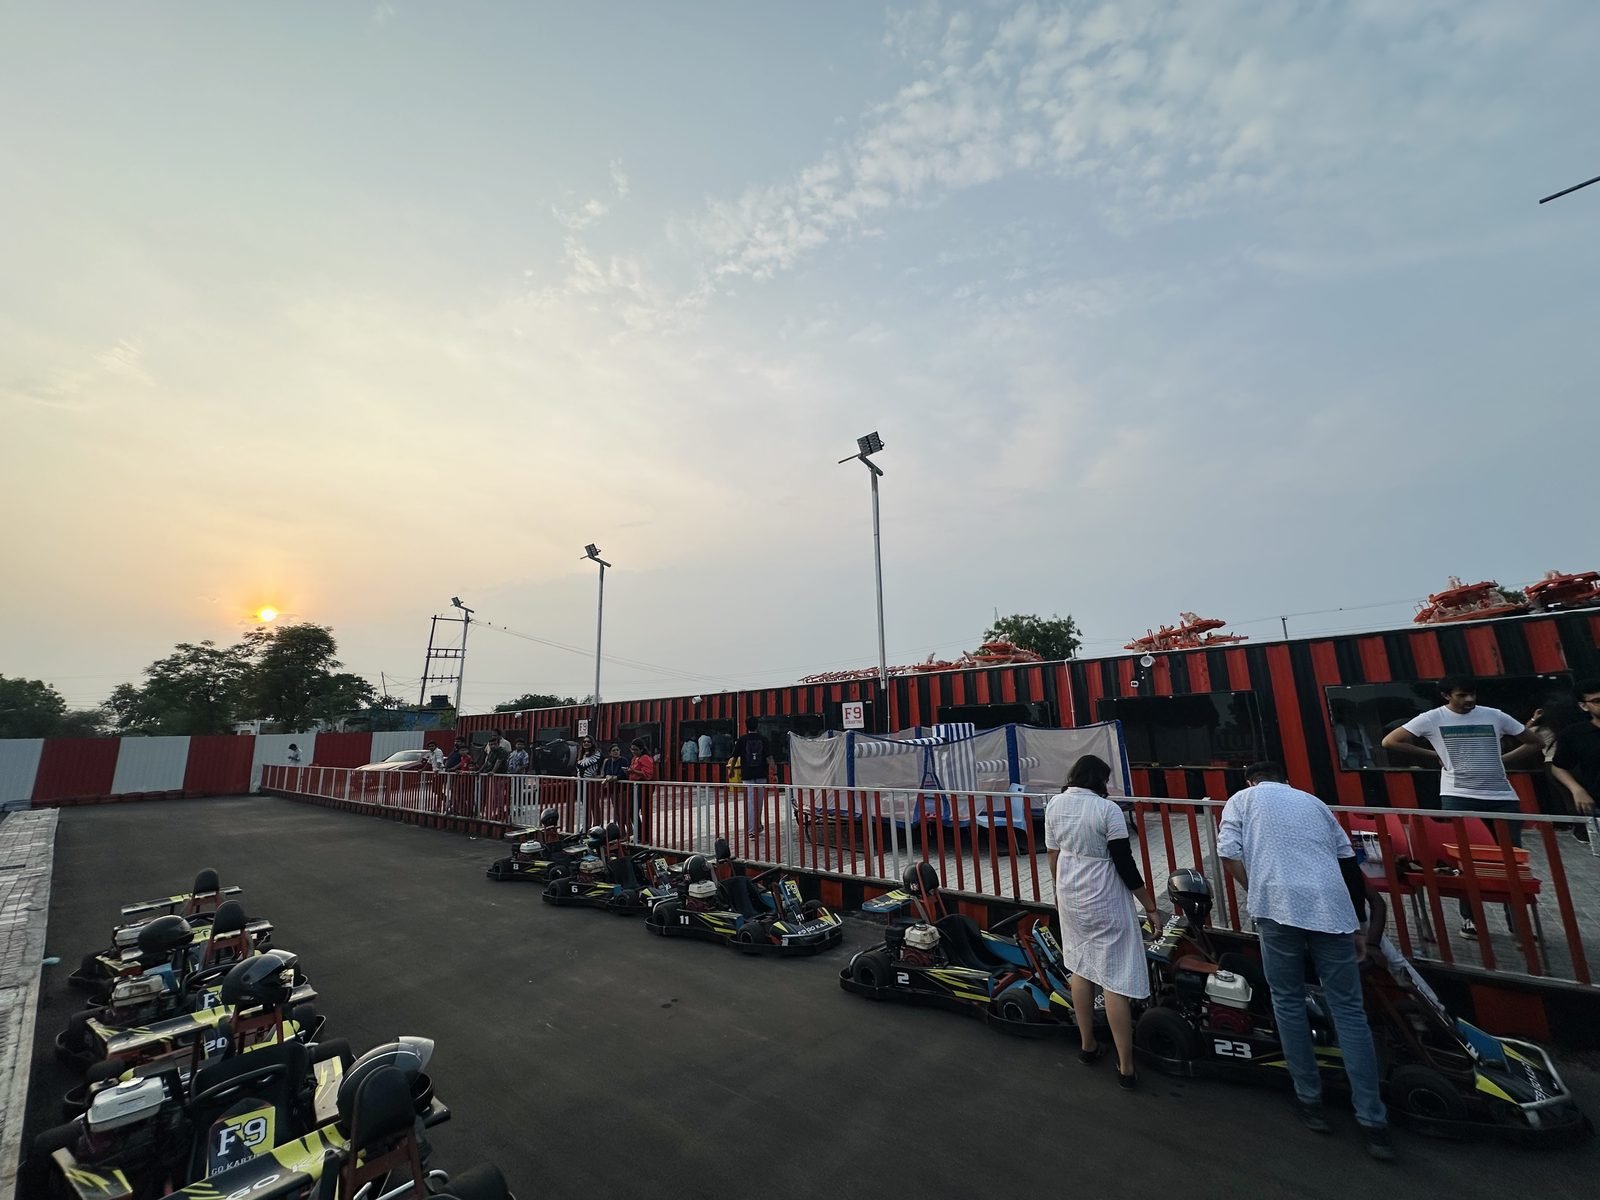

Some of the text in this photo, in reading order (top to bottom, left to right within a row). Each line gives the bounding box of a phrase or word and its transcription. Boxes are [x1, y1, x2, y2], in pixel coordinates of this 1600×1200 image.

[845, 707, 862, 720] F9
[579, 722, 587, 731] F9
[571, 885, 578, 893] 6
[785, 884, 798, 895] F9
[680, 915, 689, 925] 11
[896, 971, 910, 984] 2
[203, 991, 222, 1010] F
[203, 1037, 228, 1053] 20
[1213, 1038, 1253, 1059] 23
[216, 1116, 267, 1157] F9
[211, 1165, 224, 1176] GO
